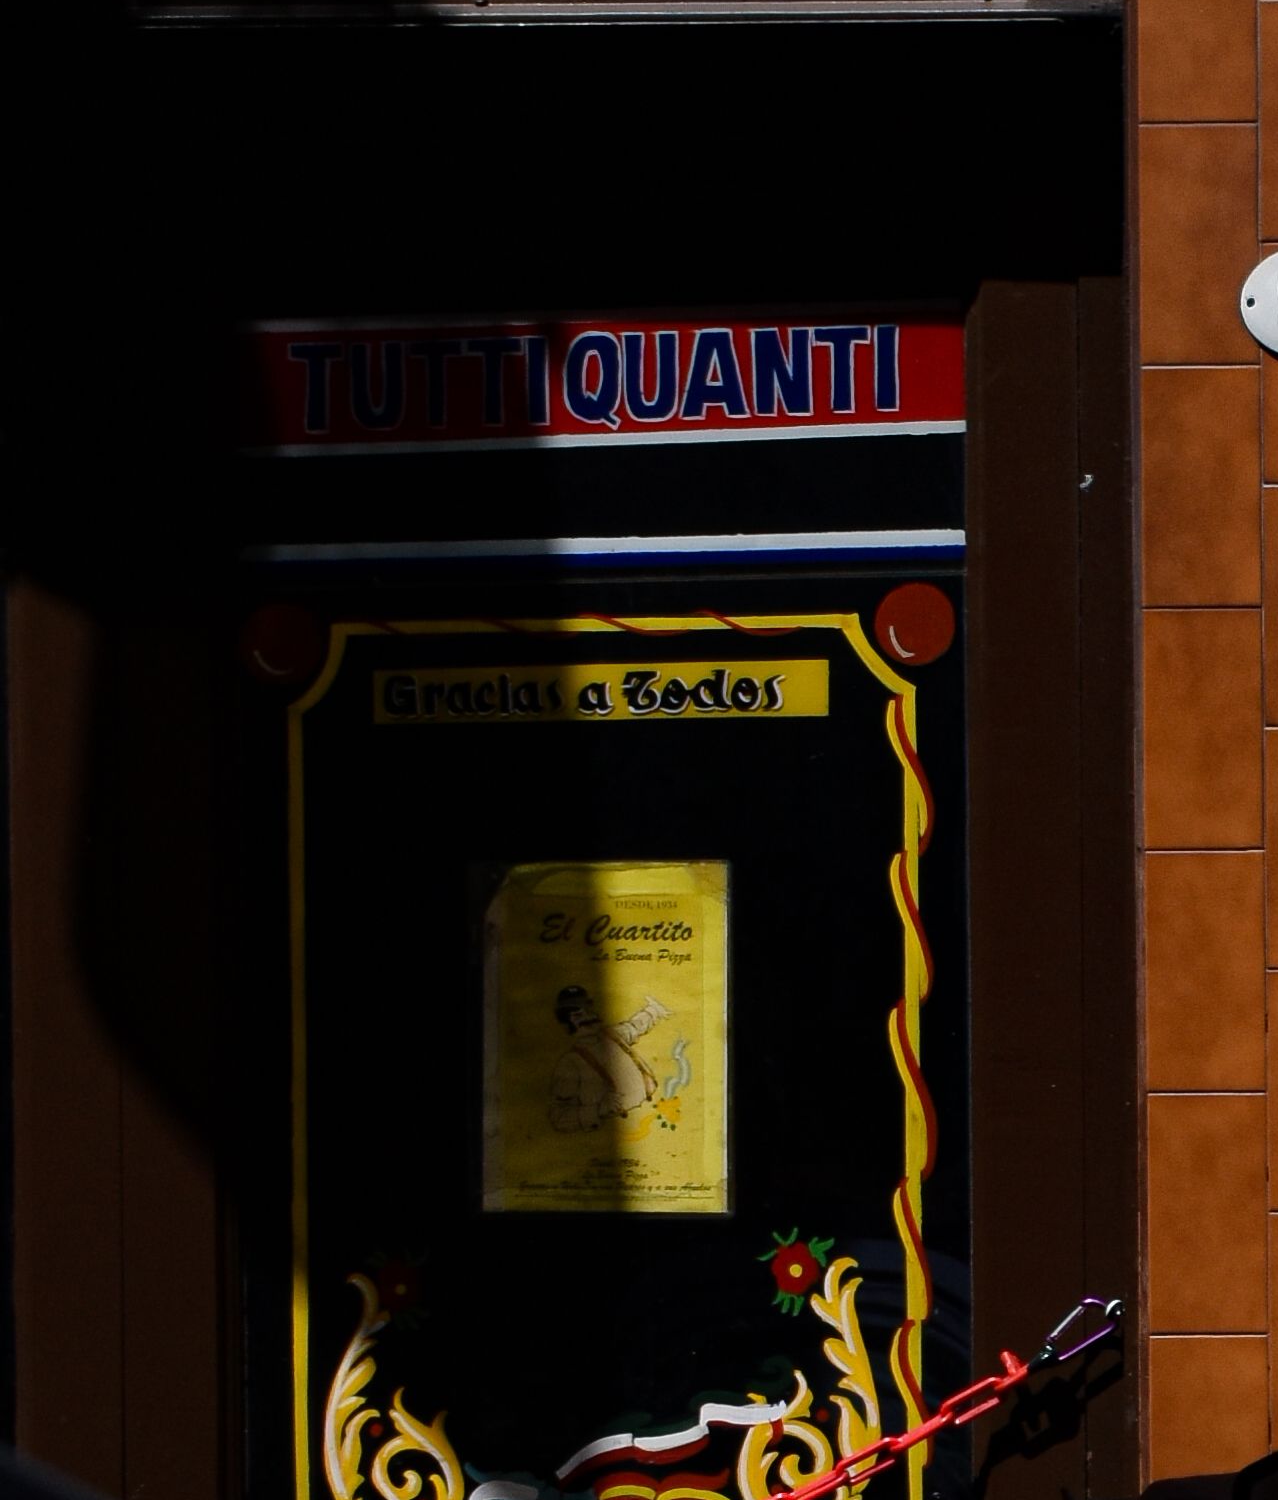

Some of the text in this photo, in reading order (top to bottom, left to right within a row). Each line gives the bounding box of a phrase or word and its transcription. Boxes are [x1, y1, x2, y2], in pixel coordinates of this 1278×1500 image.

[289, 324, 901, 434] TUTTI QUANTI
[384, 669, 785, 717] Gracias a Todos
[539, 912, 693, 947] El Cuartito
[615, 948, 652, 962] Buena
[656, 948, 692, 966] Pizza
